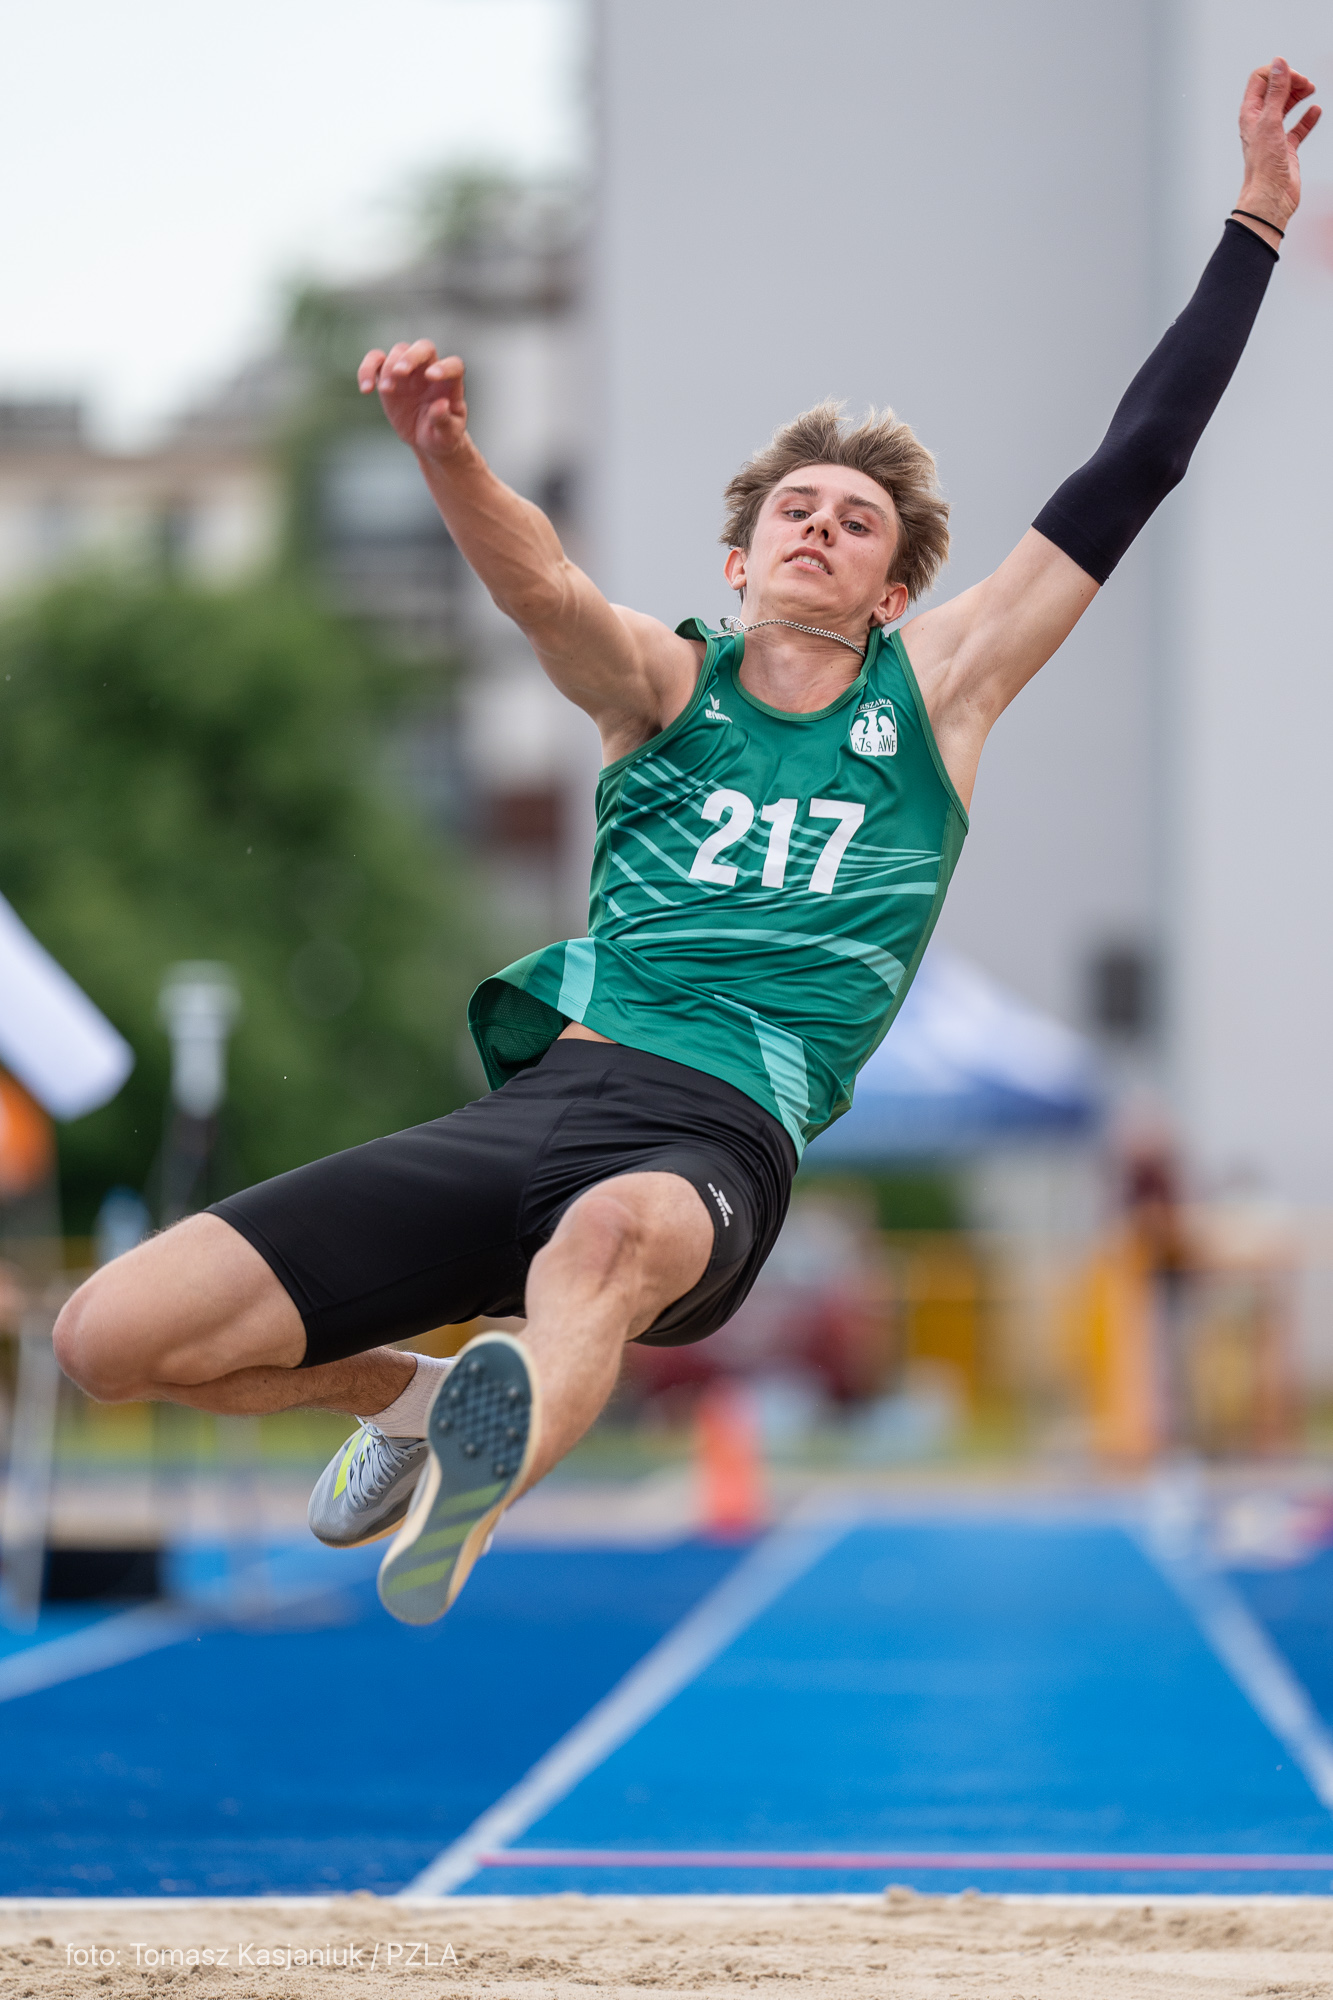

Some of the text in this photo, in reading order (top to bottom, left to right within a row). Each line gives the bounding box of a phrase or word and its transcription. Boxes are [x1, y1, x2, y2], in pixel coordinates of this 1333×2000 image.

[854, 734, 896, 752] AZS AWF
[688, 788, 866, 895] 217
